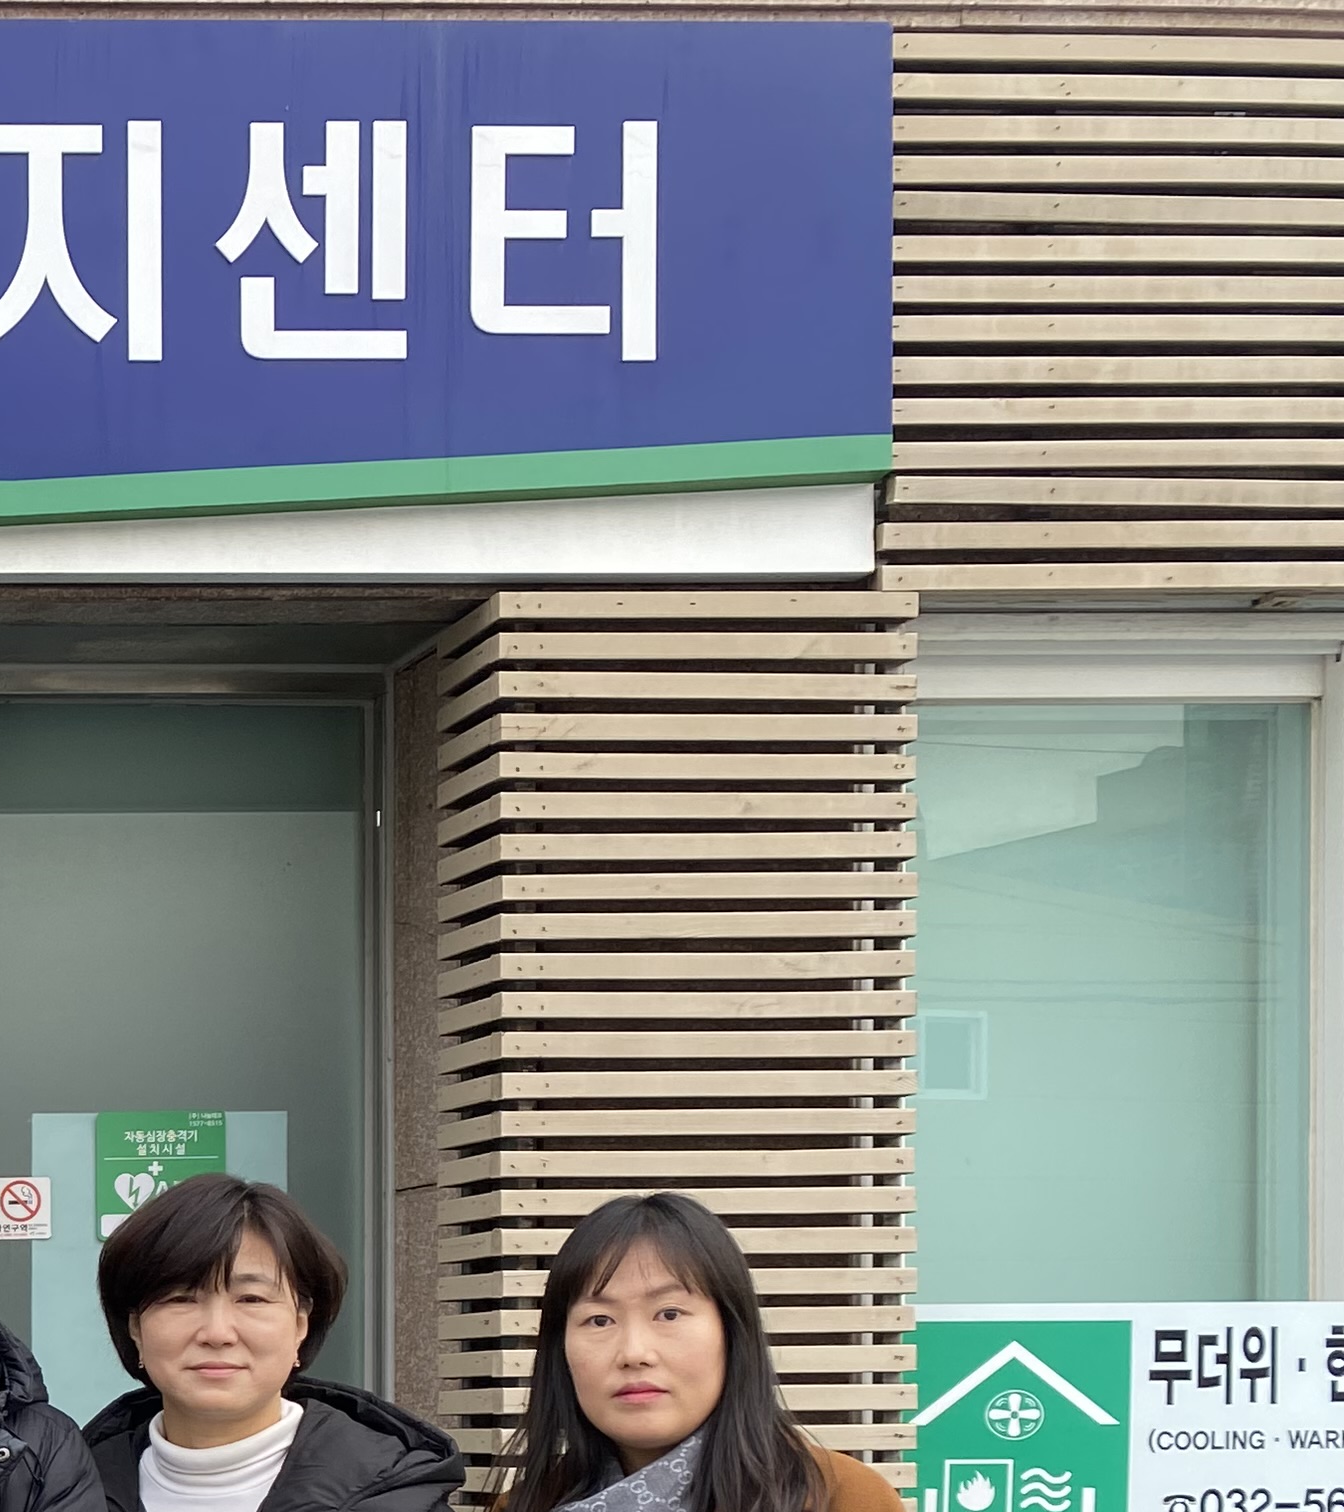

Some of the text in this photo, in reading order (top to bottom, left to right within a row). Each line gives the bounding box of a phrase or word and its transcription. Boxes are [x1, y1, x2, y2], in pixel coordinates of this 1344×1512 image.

[124, 1129, 199, 1143] 자동심장충격기
[136, 1142, 187, 1156] 설치시설
[1149, 1326, 1277, 1405] 무더위
[1148, 1428, 1344, 1454] (COOLING WAR
